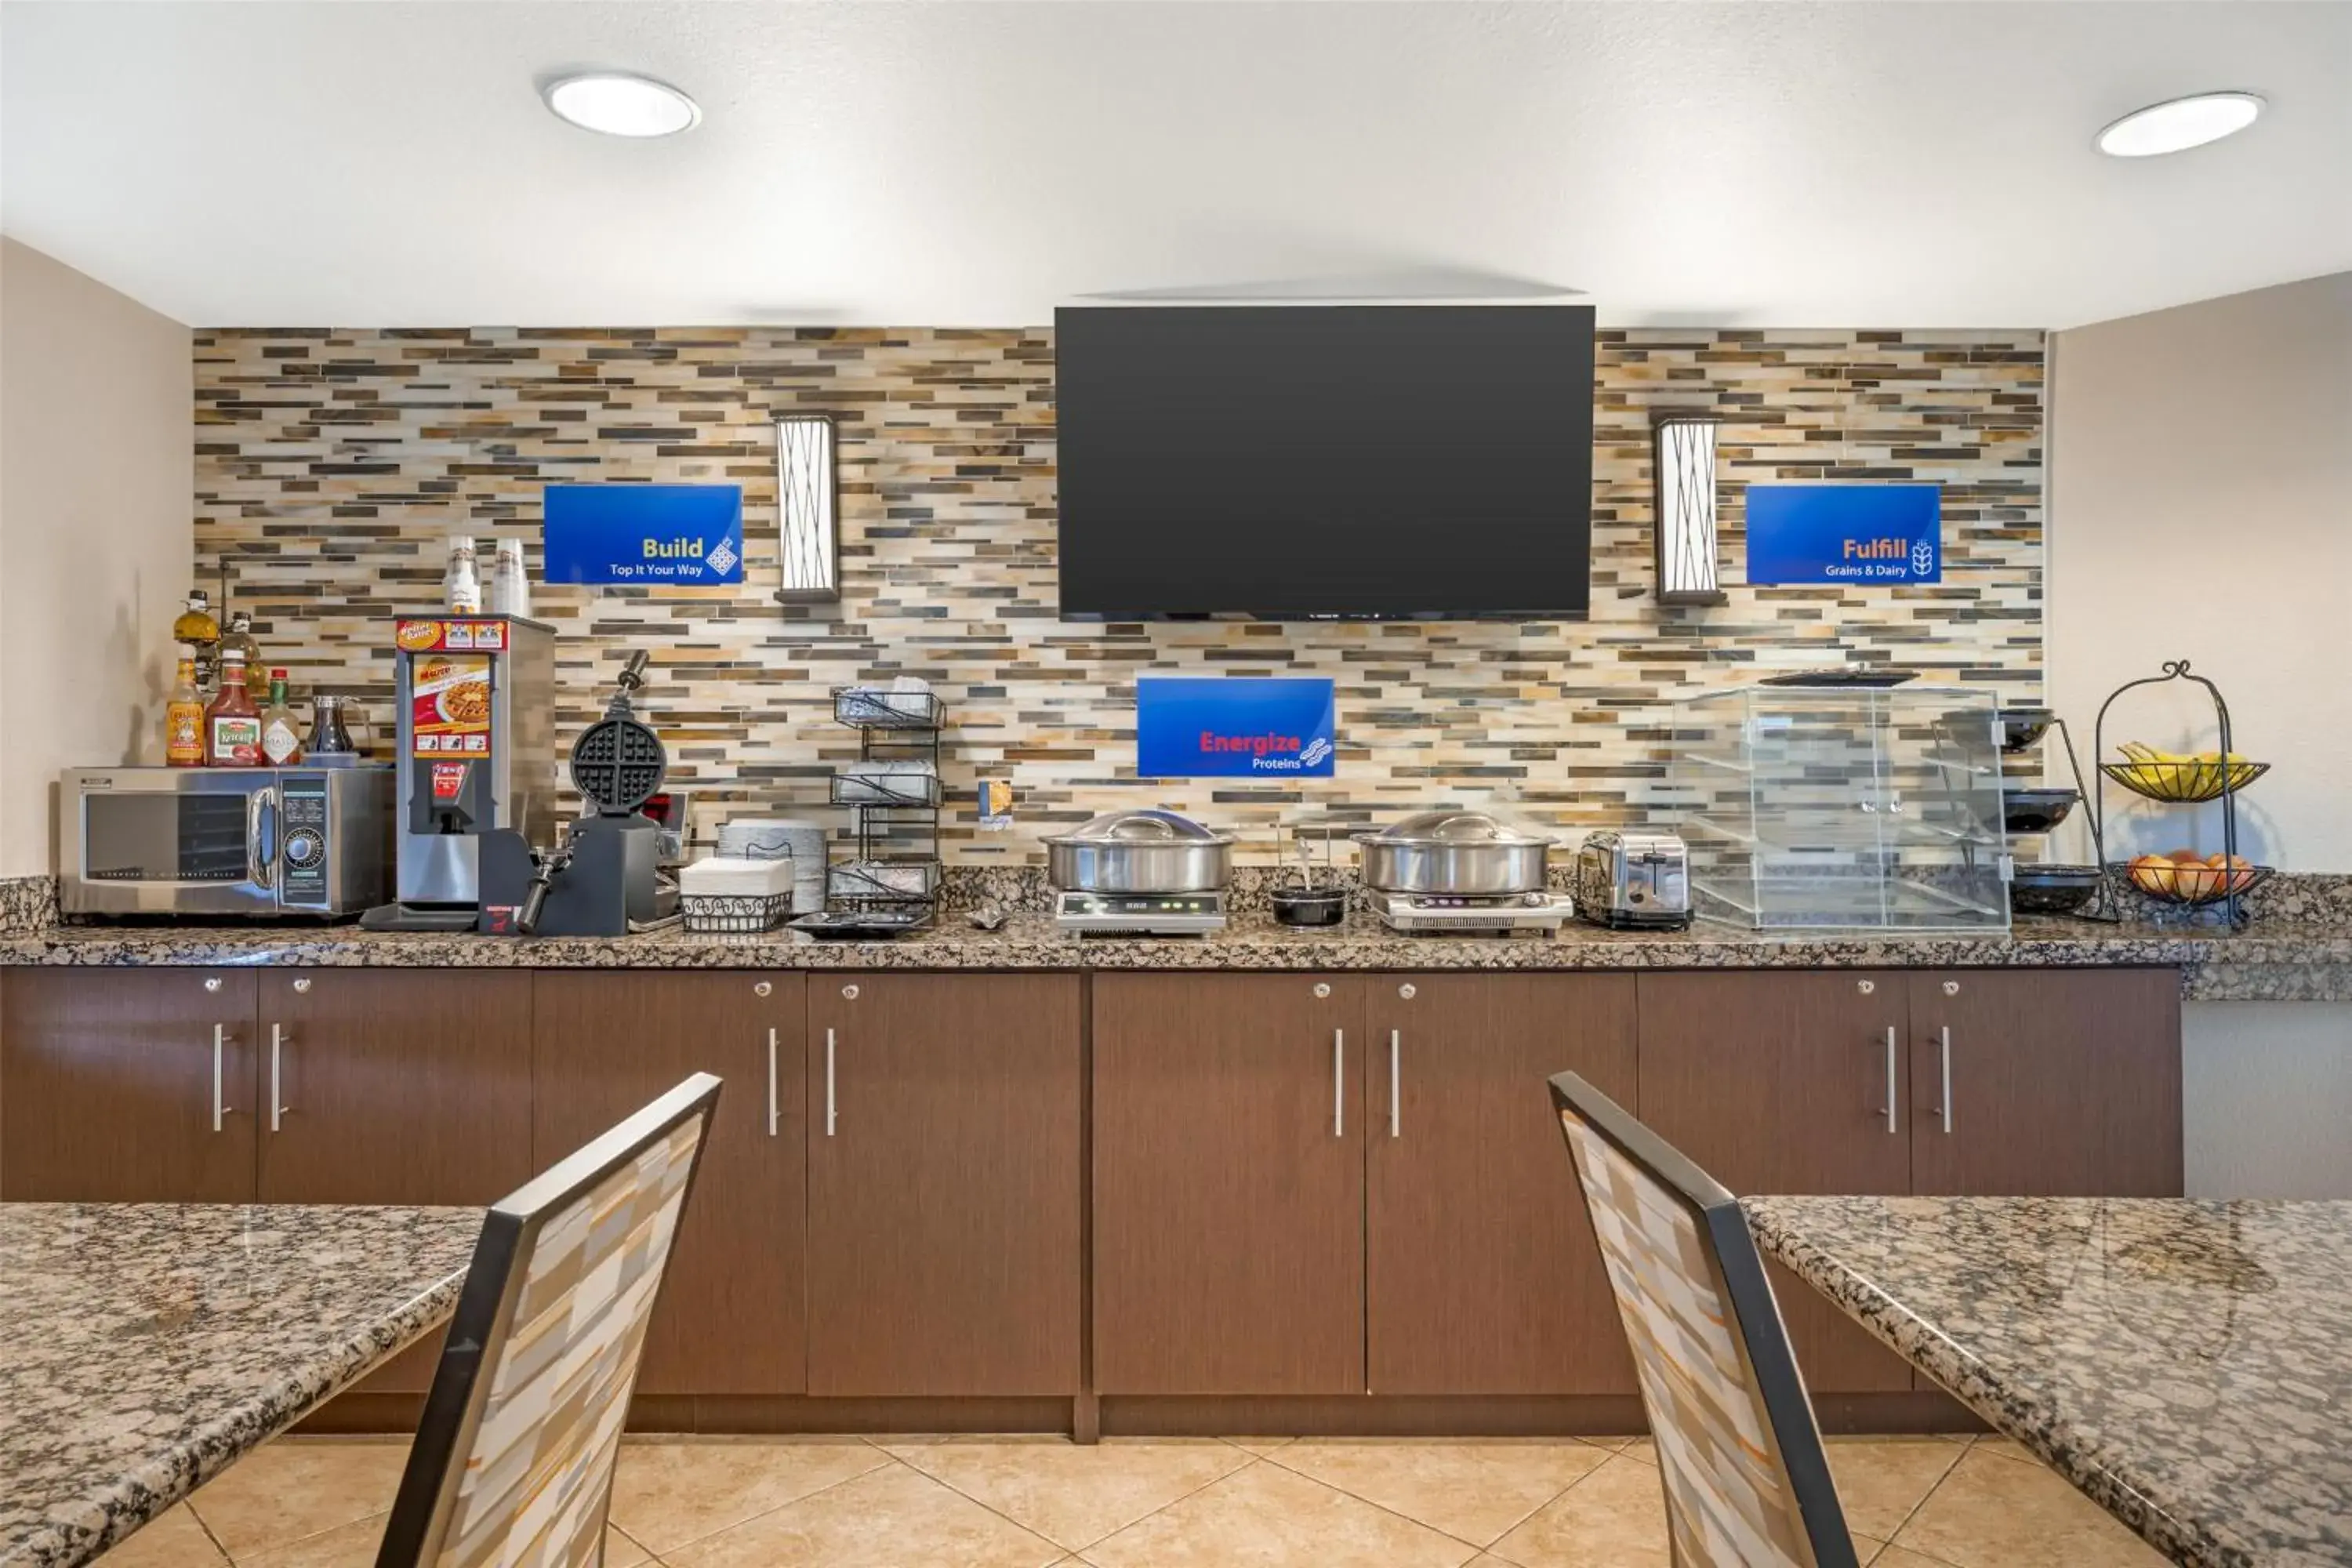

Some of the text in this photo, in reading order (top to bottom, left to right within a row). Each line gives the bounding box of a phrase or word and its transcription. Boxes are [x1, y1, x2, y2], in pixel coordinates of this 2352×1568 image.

[643, 537, 703, 558] Build
[1843, 539, 1907, 559] Fulfill
[610, 564, 703, 577] Top It Your Way
[1825, 564, 1907, 577] Grains & Dairy
[1200, 731, 1301, 757] Energize
[1252, 757, 1301, 769] Proteins
